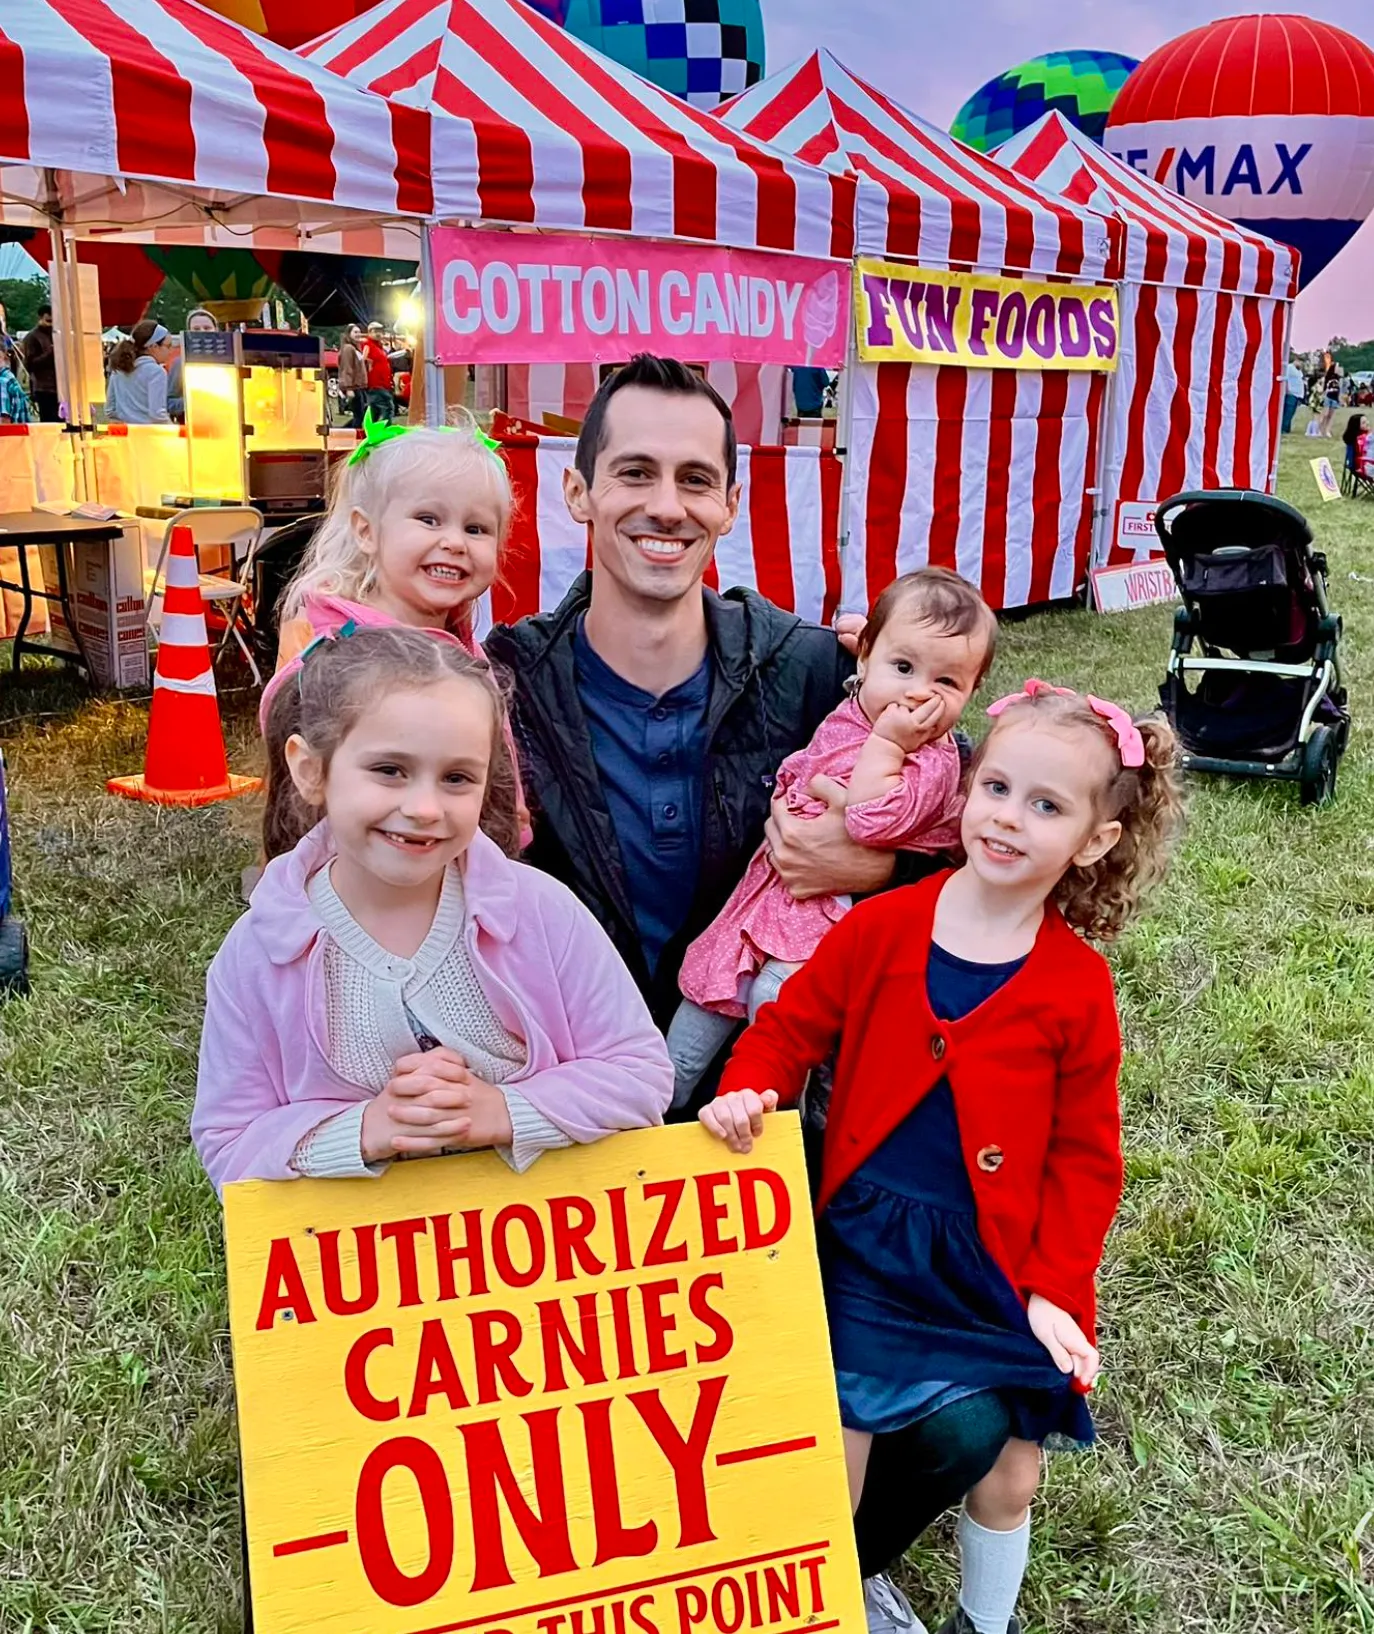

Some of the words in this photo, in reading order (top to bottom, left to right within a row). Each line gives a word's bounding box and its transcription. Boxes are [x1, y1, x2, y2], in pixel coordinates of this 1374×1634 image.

[1111, 143, 1313, 196] /MAX
[442, 259, 651, 334] COTTON
[659, 269, 804, 340] CANDY
[863, 273, 961, 353] FUN
[968, 289, 1117, 359] FOODS
[1128, 522, 1154, 532] FIRST
[1124, 570, 1177, 602] WRISTB
[256, 1168, 791, 1330] AUTHORIZED
[345, 1272, 733, 1421] CARNIES
[356, 1376, 728, 1606] ONLY
[675, 1556, 826, 1634] POINT
